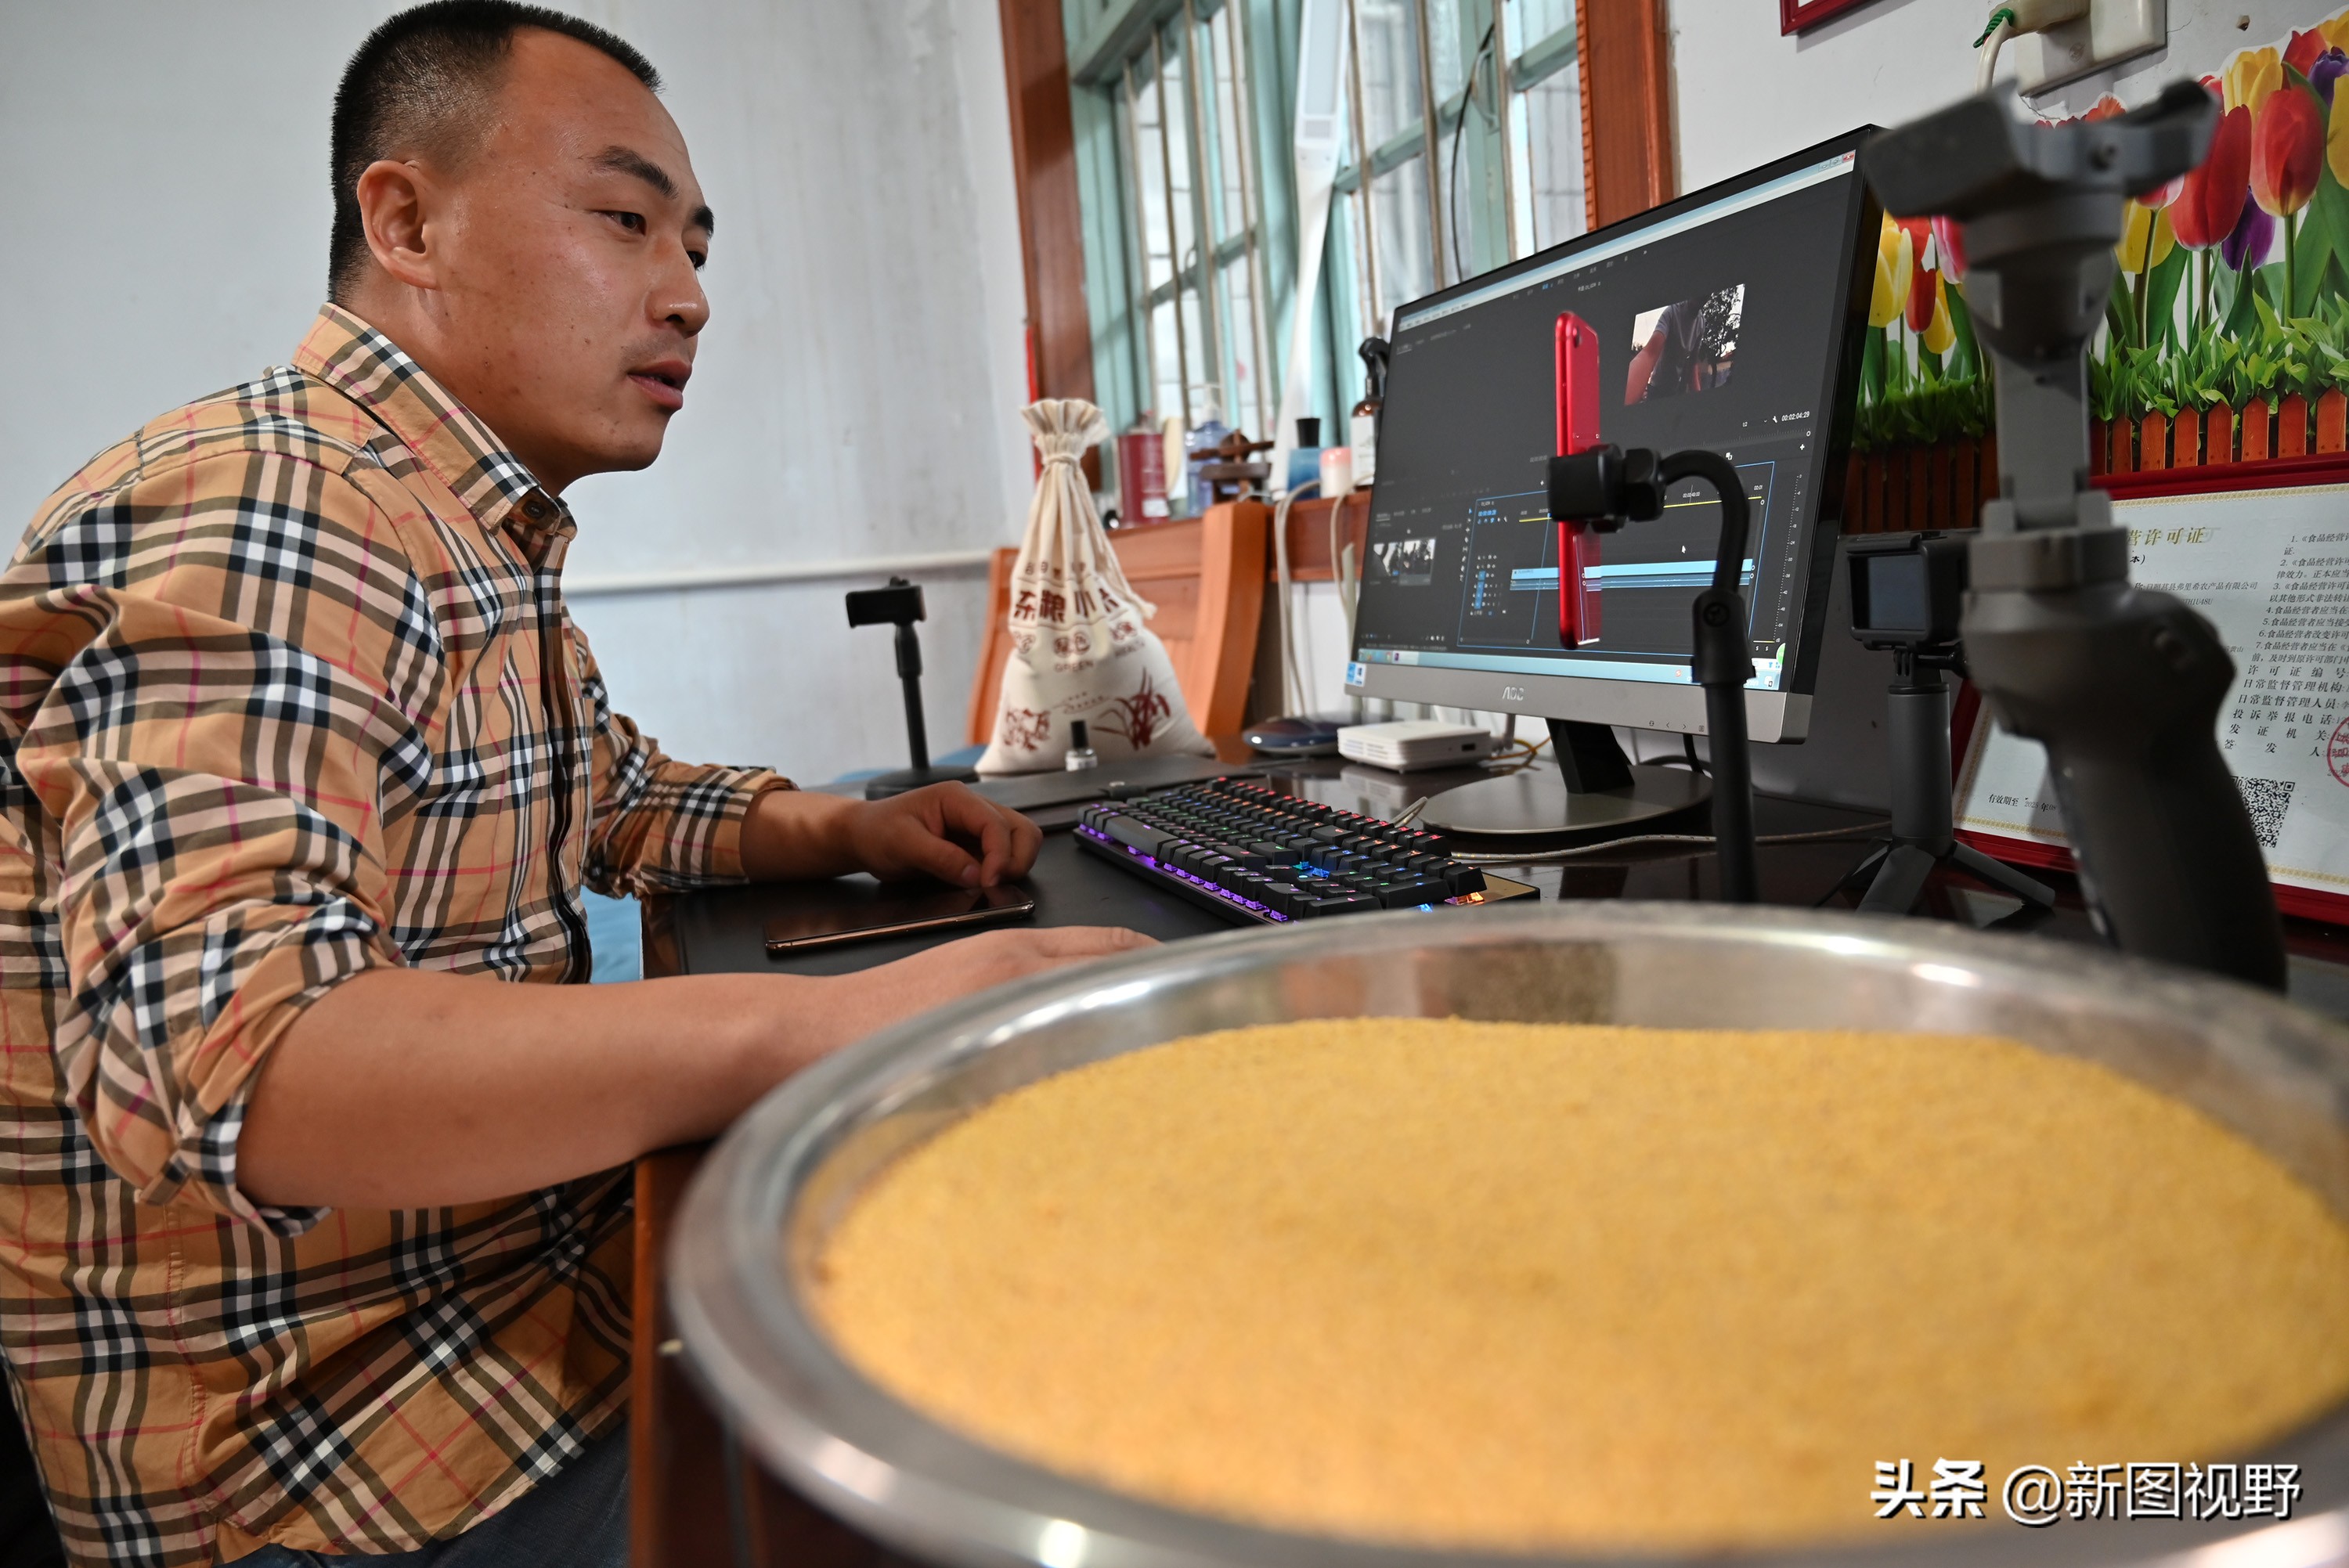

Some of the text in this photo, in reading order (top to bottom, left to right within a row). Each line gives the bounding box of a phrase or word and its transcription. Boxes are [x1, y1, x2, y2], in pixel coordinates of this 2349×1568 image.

[1781, 411, 1810, 422] 00:02:04:29
[1503, 686, 1525, 701] AOC
[1988, 794, 2019, 807] 有效期至
